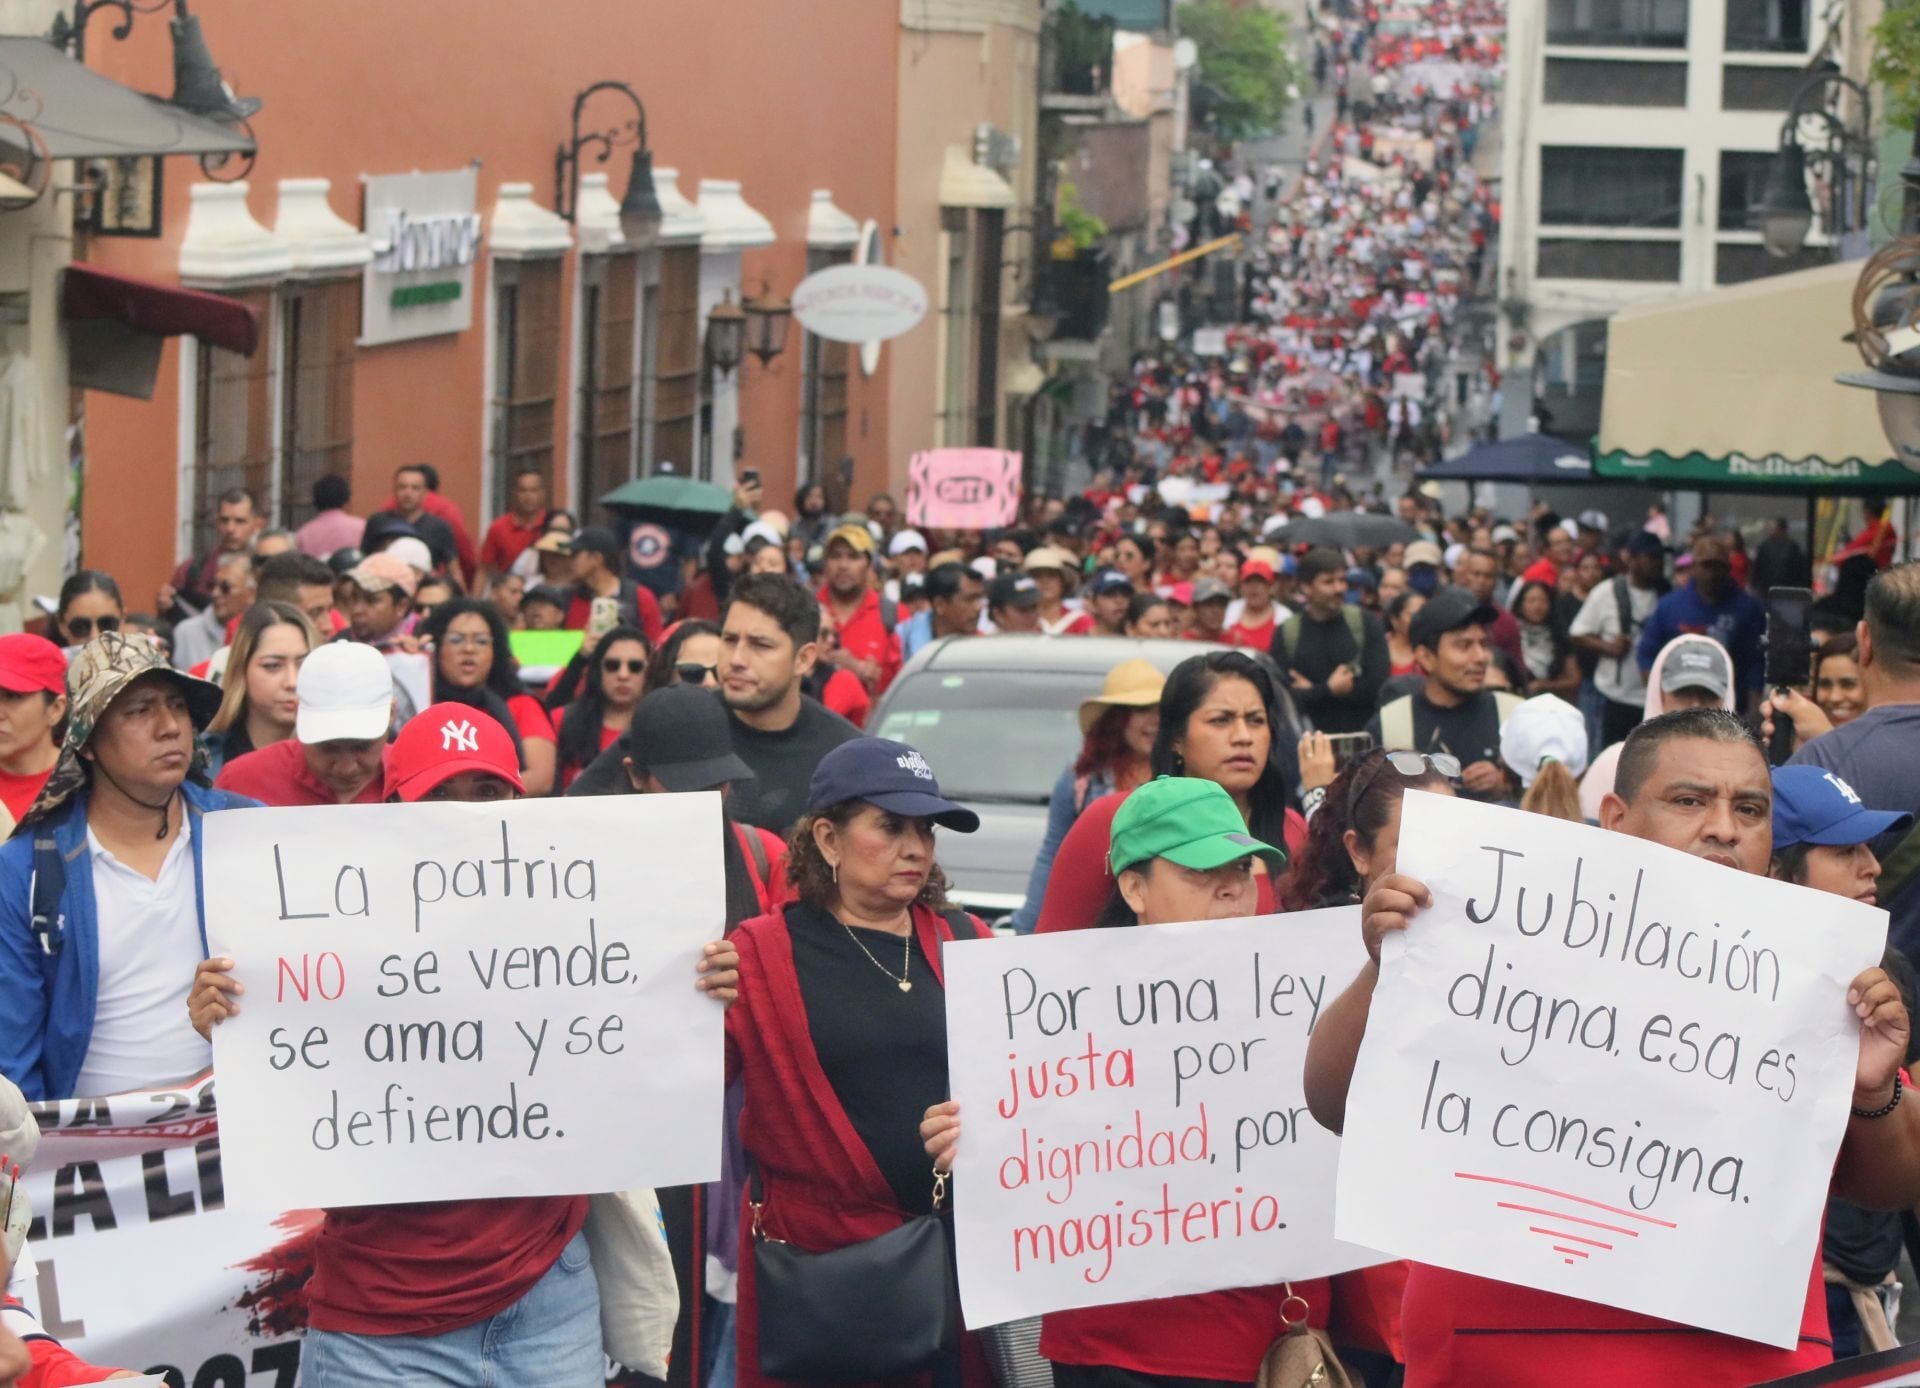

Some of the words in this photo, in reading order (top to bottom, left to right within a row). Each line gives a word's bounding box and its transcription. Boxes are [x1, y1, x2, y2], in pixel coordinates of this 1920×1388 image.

[440, 719, 479, 751] NY
[1823, 773, 1861, 804] LA
[273, 843, 370, 921] La
[412, 819, 597, 933] patria
[277, 951, 346, 1003] NO
[376, 950, 441, 998] se
[468, 917, 639, 990] vende,
[1464, 845, 1782, 1002] Jubilación
[1001, 967, 1092, 1040] Por
[1116, 978, 1219, 1026] una
[1254, 952, 1327, 1037] ley
[268, 1026, 330, 1071] se
[364, 1019, 484, 1064] ama
[514, 1018, 549, 1077] y
[564, 1014, 625, 1056] se
[998, 1032, 1135, 1120] justa
[1173, 1038, 1267, 1108] por
[1639, 1012, 1740, 1085] esa
[1755, 1045, 1797, 1103] es
[311, 1081, 566, 1152] defiende.
[999, 1102, 1217, 1205] dignidad,
[1235, 1105, 1310, 1174] por
[1421, 1059, 1471, 1137] la
[1491, 1102, 1751, 1211] consigna.
[1012, 1183, 1288, 1284] magisterio.
